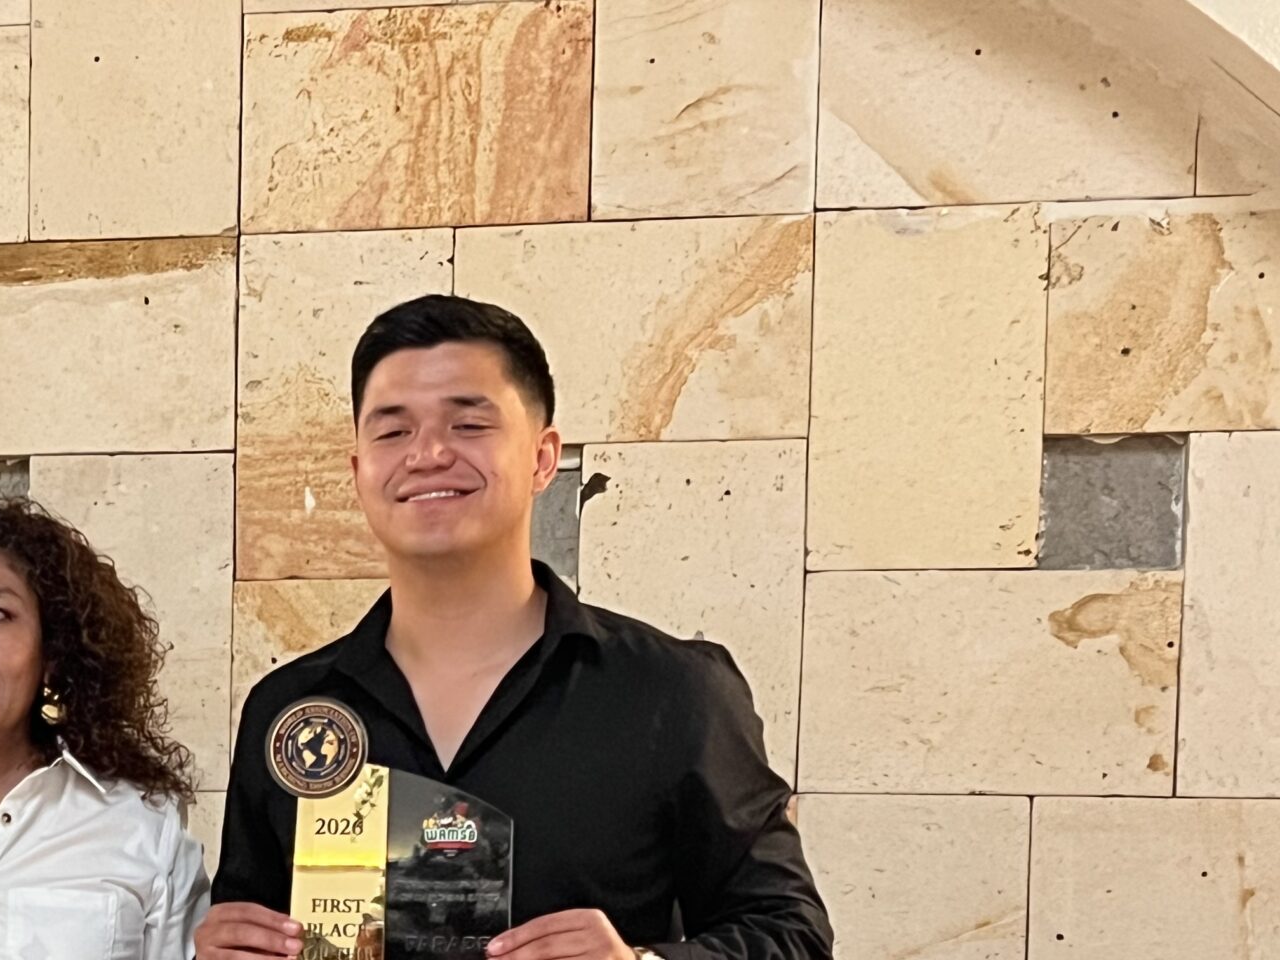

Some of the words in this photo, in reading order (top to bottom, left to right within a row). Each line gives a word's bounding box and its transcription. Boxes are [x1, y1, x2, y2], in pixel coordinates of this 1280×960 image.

[314, 817, 364, 836] 2026
[424, 829, 476, 842] WAMSB
[311, 898, 365, 914] FIRST
